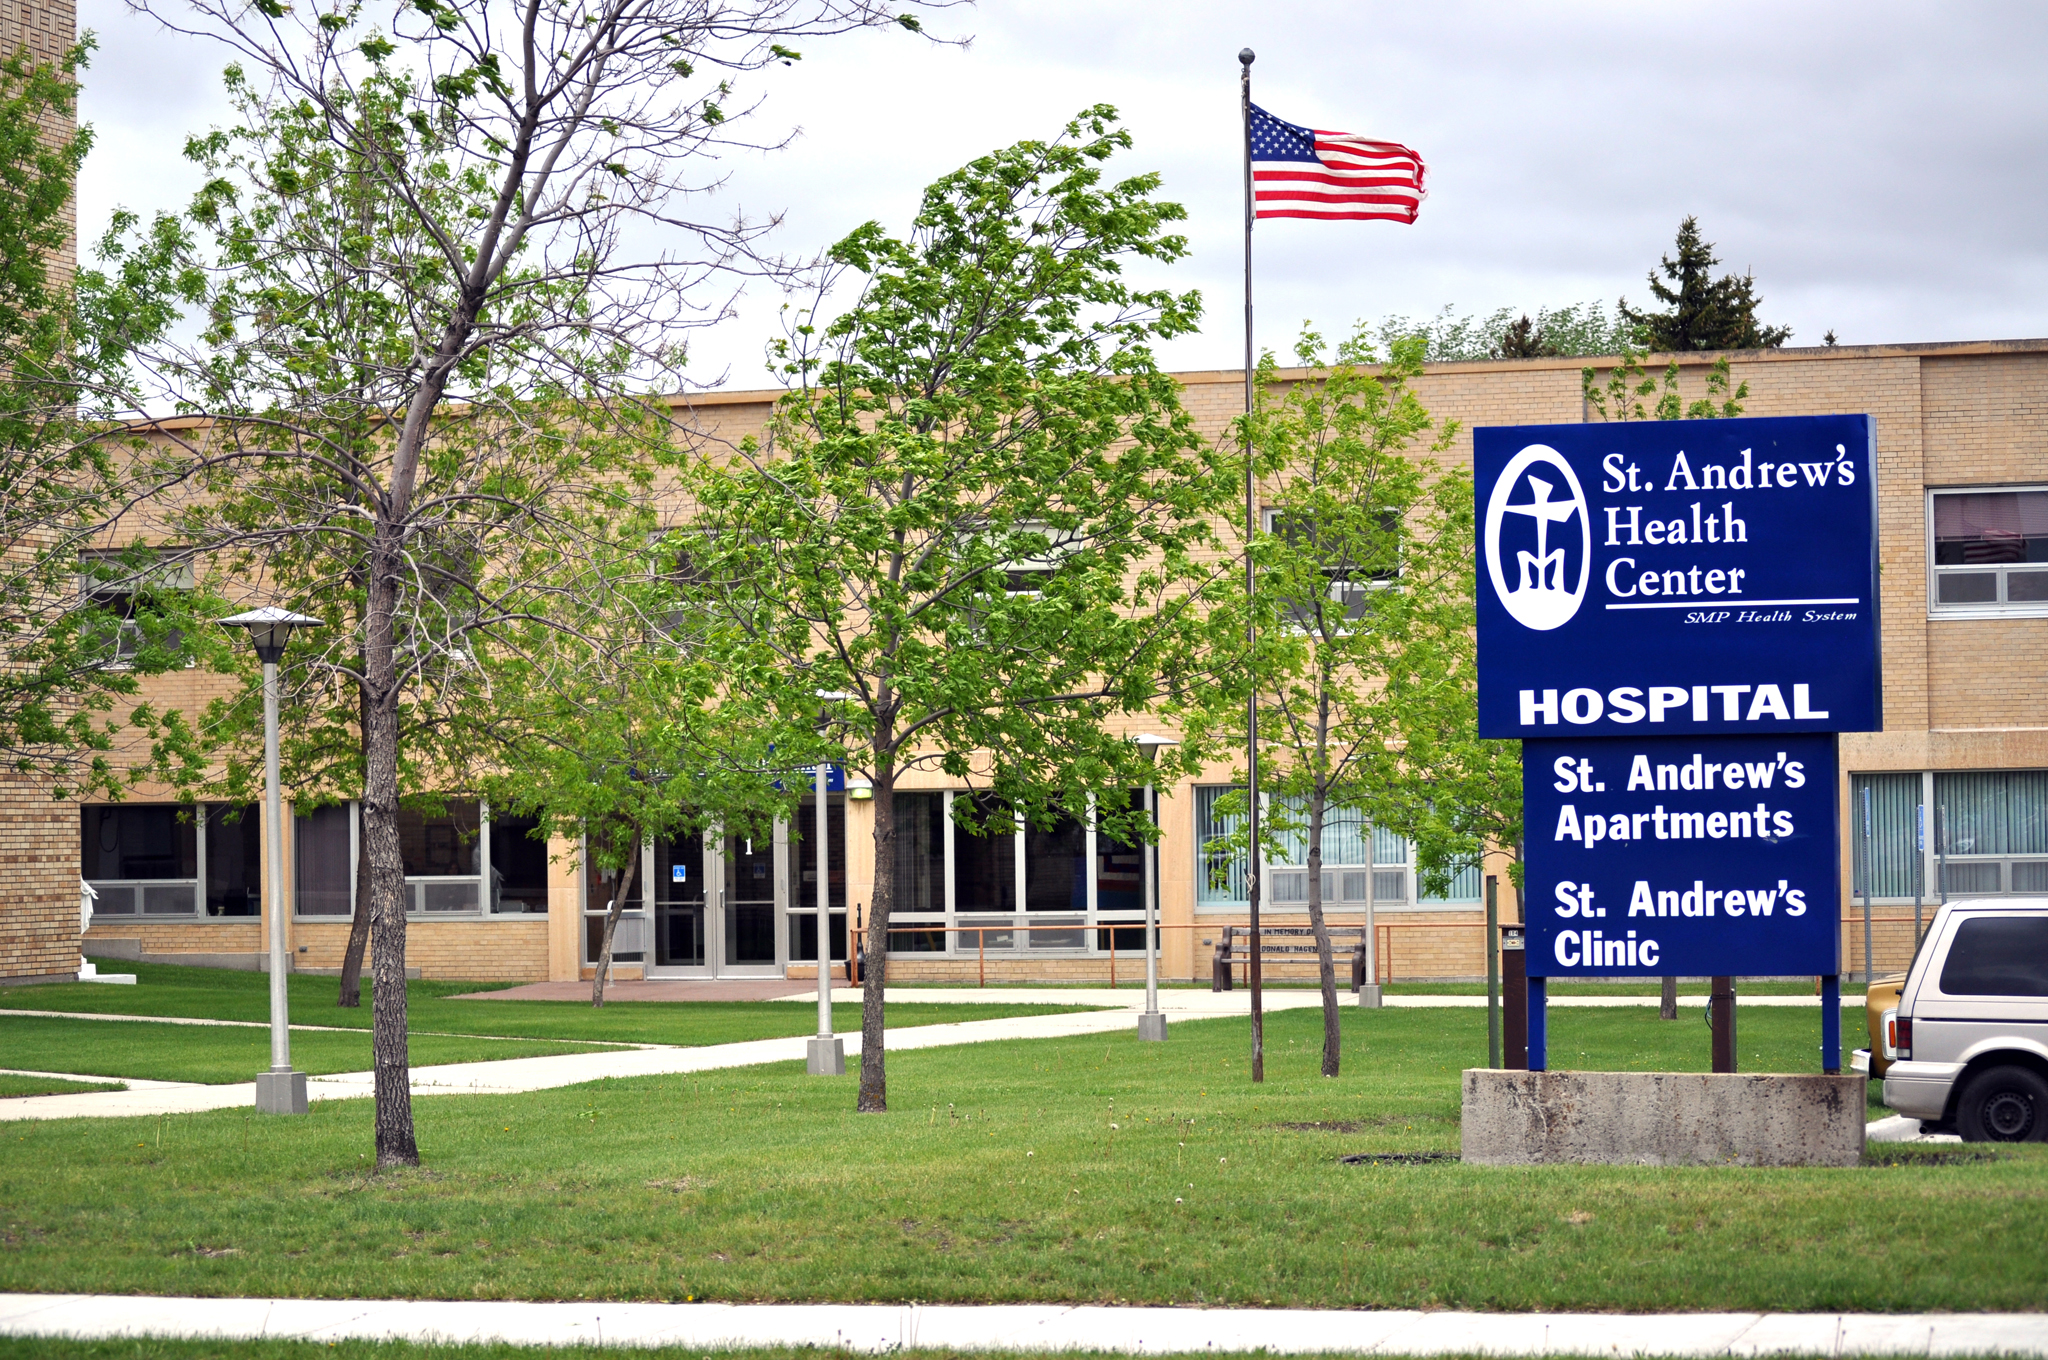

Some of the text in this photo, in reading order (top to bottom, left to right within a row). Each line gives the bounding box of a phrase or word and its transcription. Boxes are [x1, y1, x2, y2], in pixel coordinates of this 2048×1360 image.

[1603, 444, 1856, 493] St. Andrew's
[1604, 502, 1748, 546] Health
[1605, 558, 1746, 597] Center
[1684, 610, 1857, 624] SMP Health System
[1519, 683, 1829, 726] HOSPITAL
[1553, 752, 1806, 793] St. Andrew's
[1554, 803, 1795, 848] Apartments
[1554, 879, 1807, 918] St. Andrew's
[1554, 930, 1660, 967] Clinic
